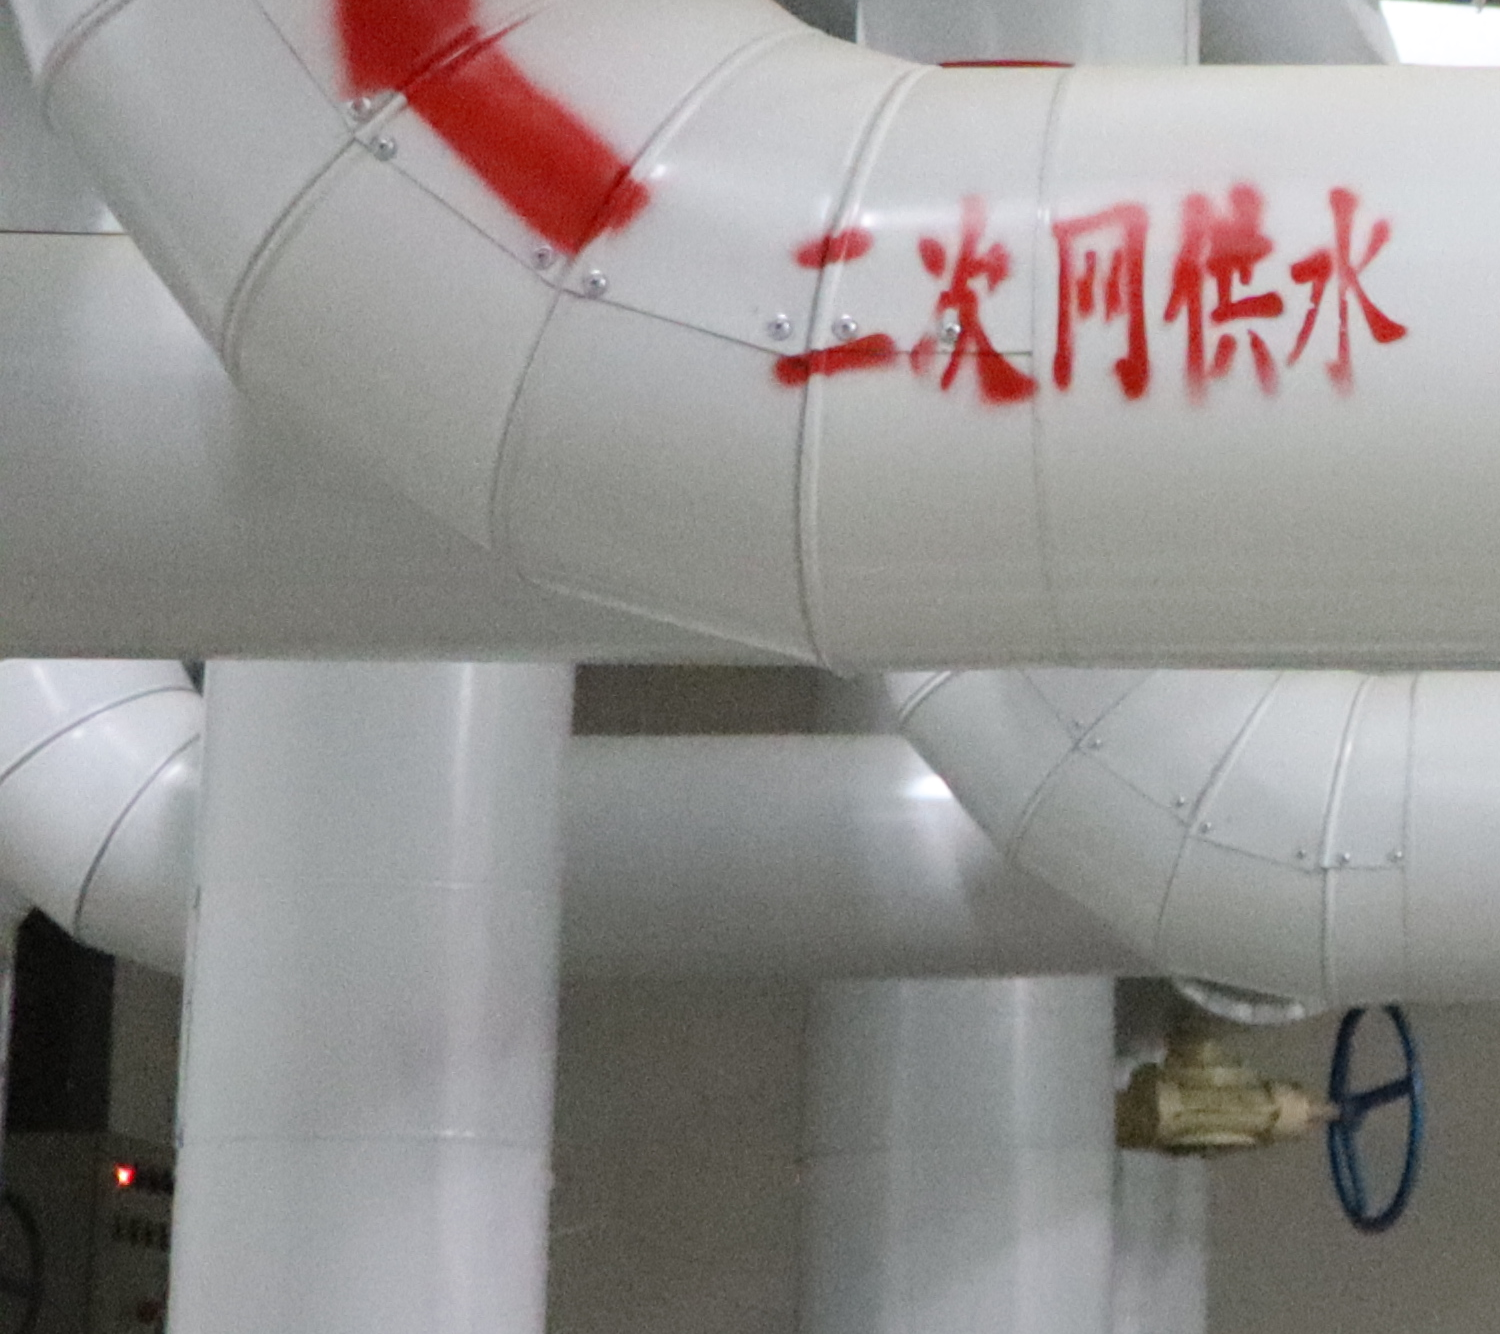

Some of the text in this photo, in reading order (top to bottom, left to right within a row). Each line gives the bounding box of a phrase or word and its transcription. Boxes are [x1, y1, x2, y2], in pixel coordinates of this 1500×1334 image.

[771, 179, 1408, 407] 二次网供水
